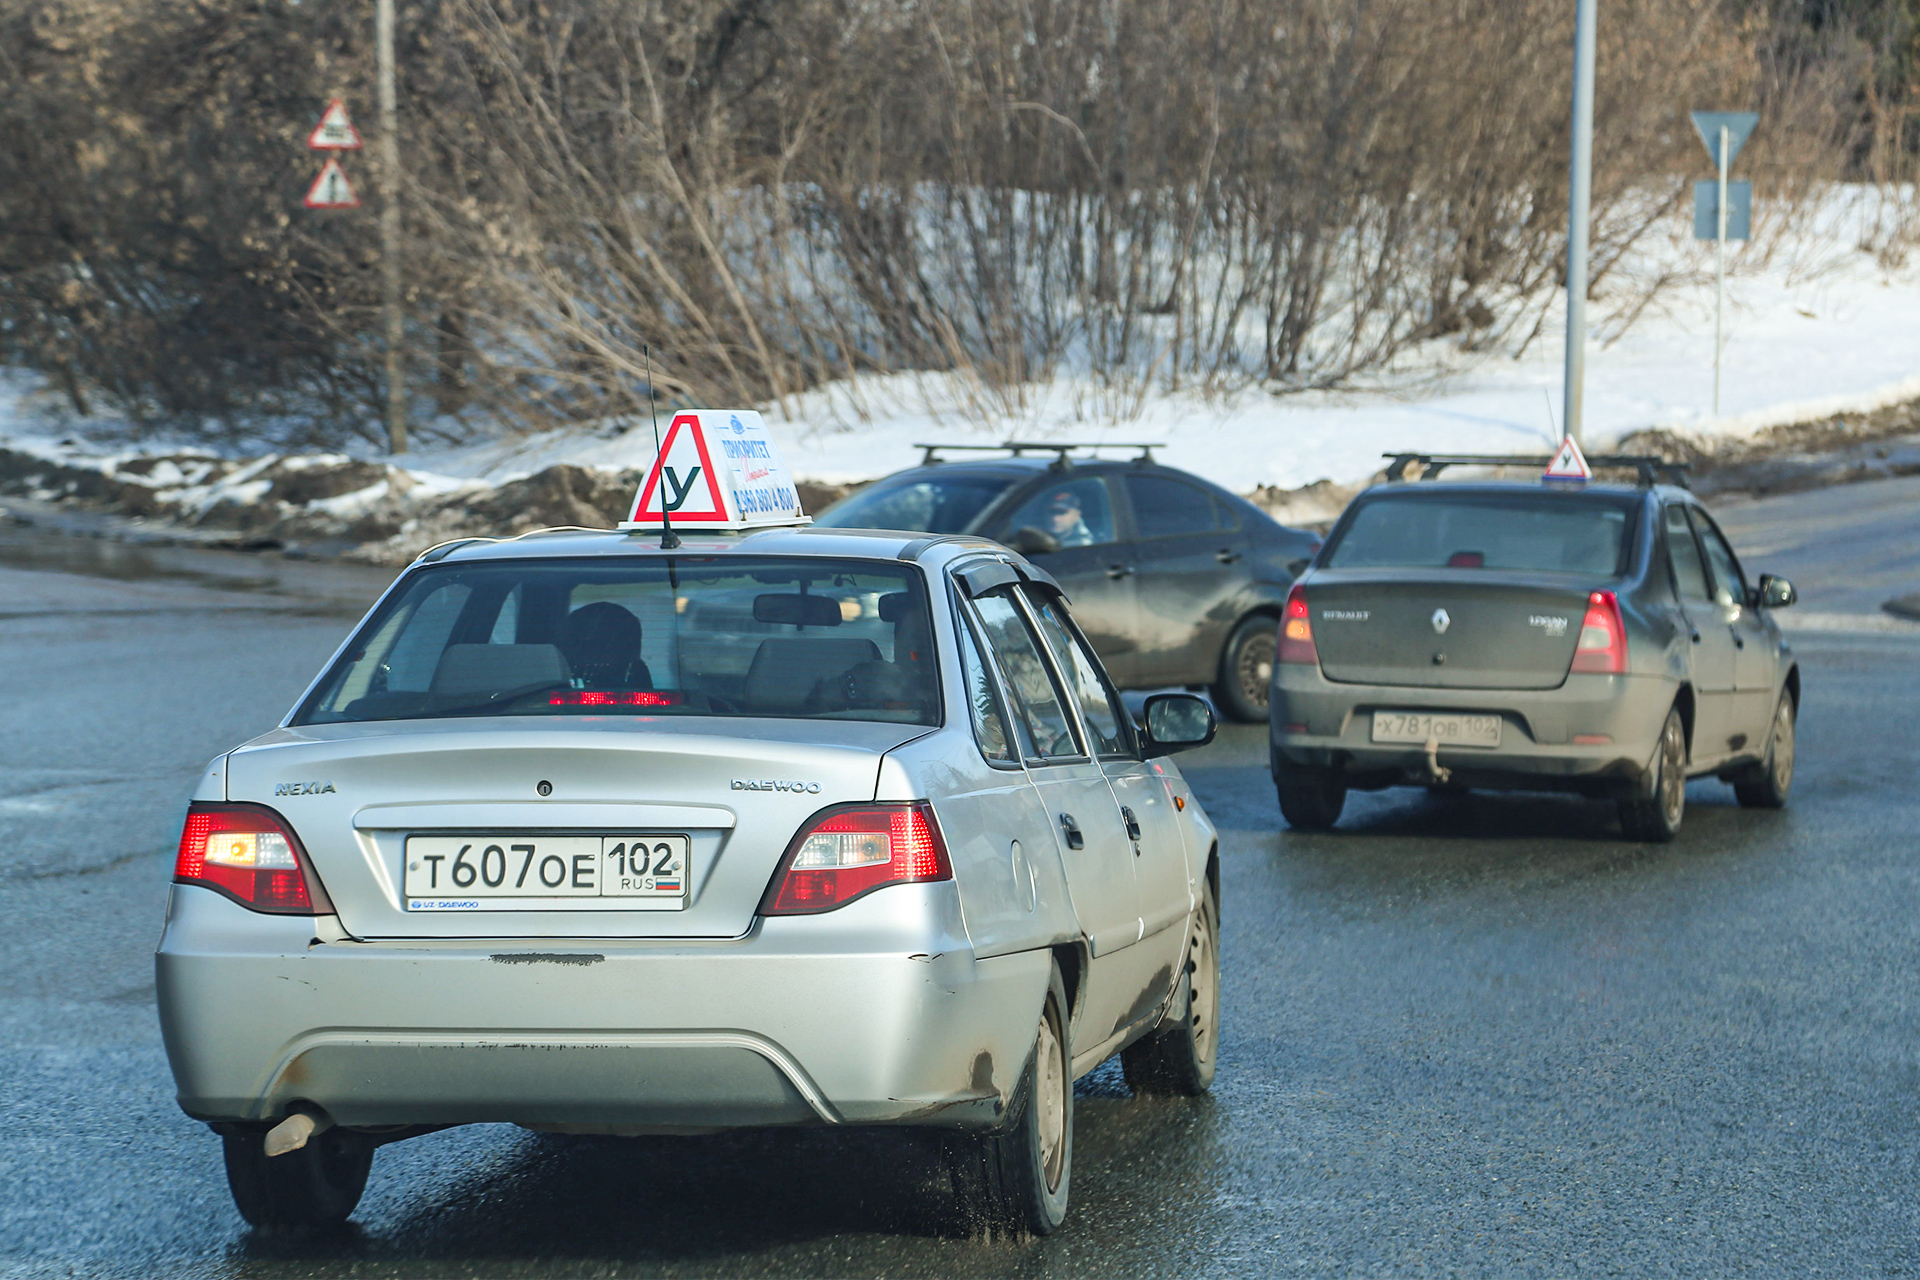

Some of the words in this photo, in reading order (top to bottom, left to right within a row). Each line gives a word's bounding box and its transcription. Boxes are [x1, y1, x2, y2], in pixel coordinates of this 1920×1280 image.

[721, 440, 771, 458] ПРИОРИТЕТ
[664, 466, 702, 511] У
[275, 780, 337, 796] NEXIA
[730, 779, 823, 794] DAEWOO
[608, 842, 674, 877] 102
[621, 878, 654, 890] RUS
